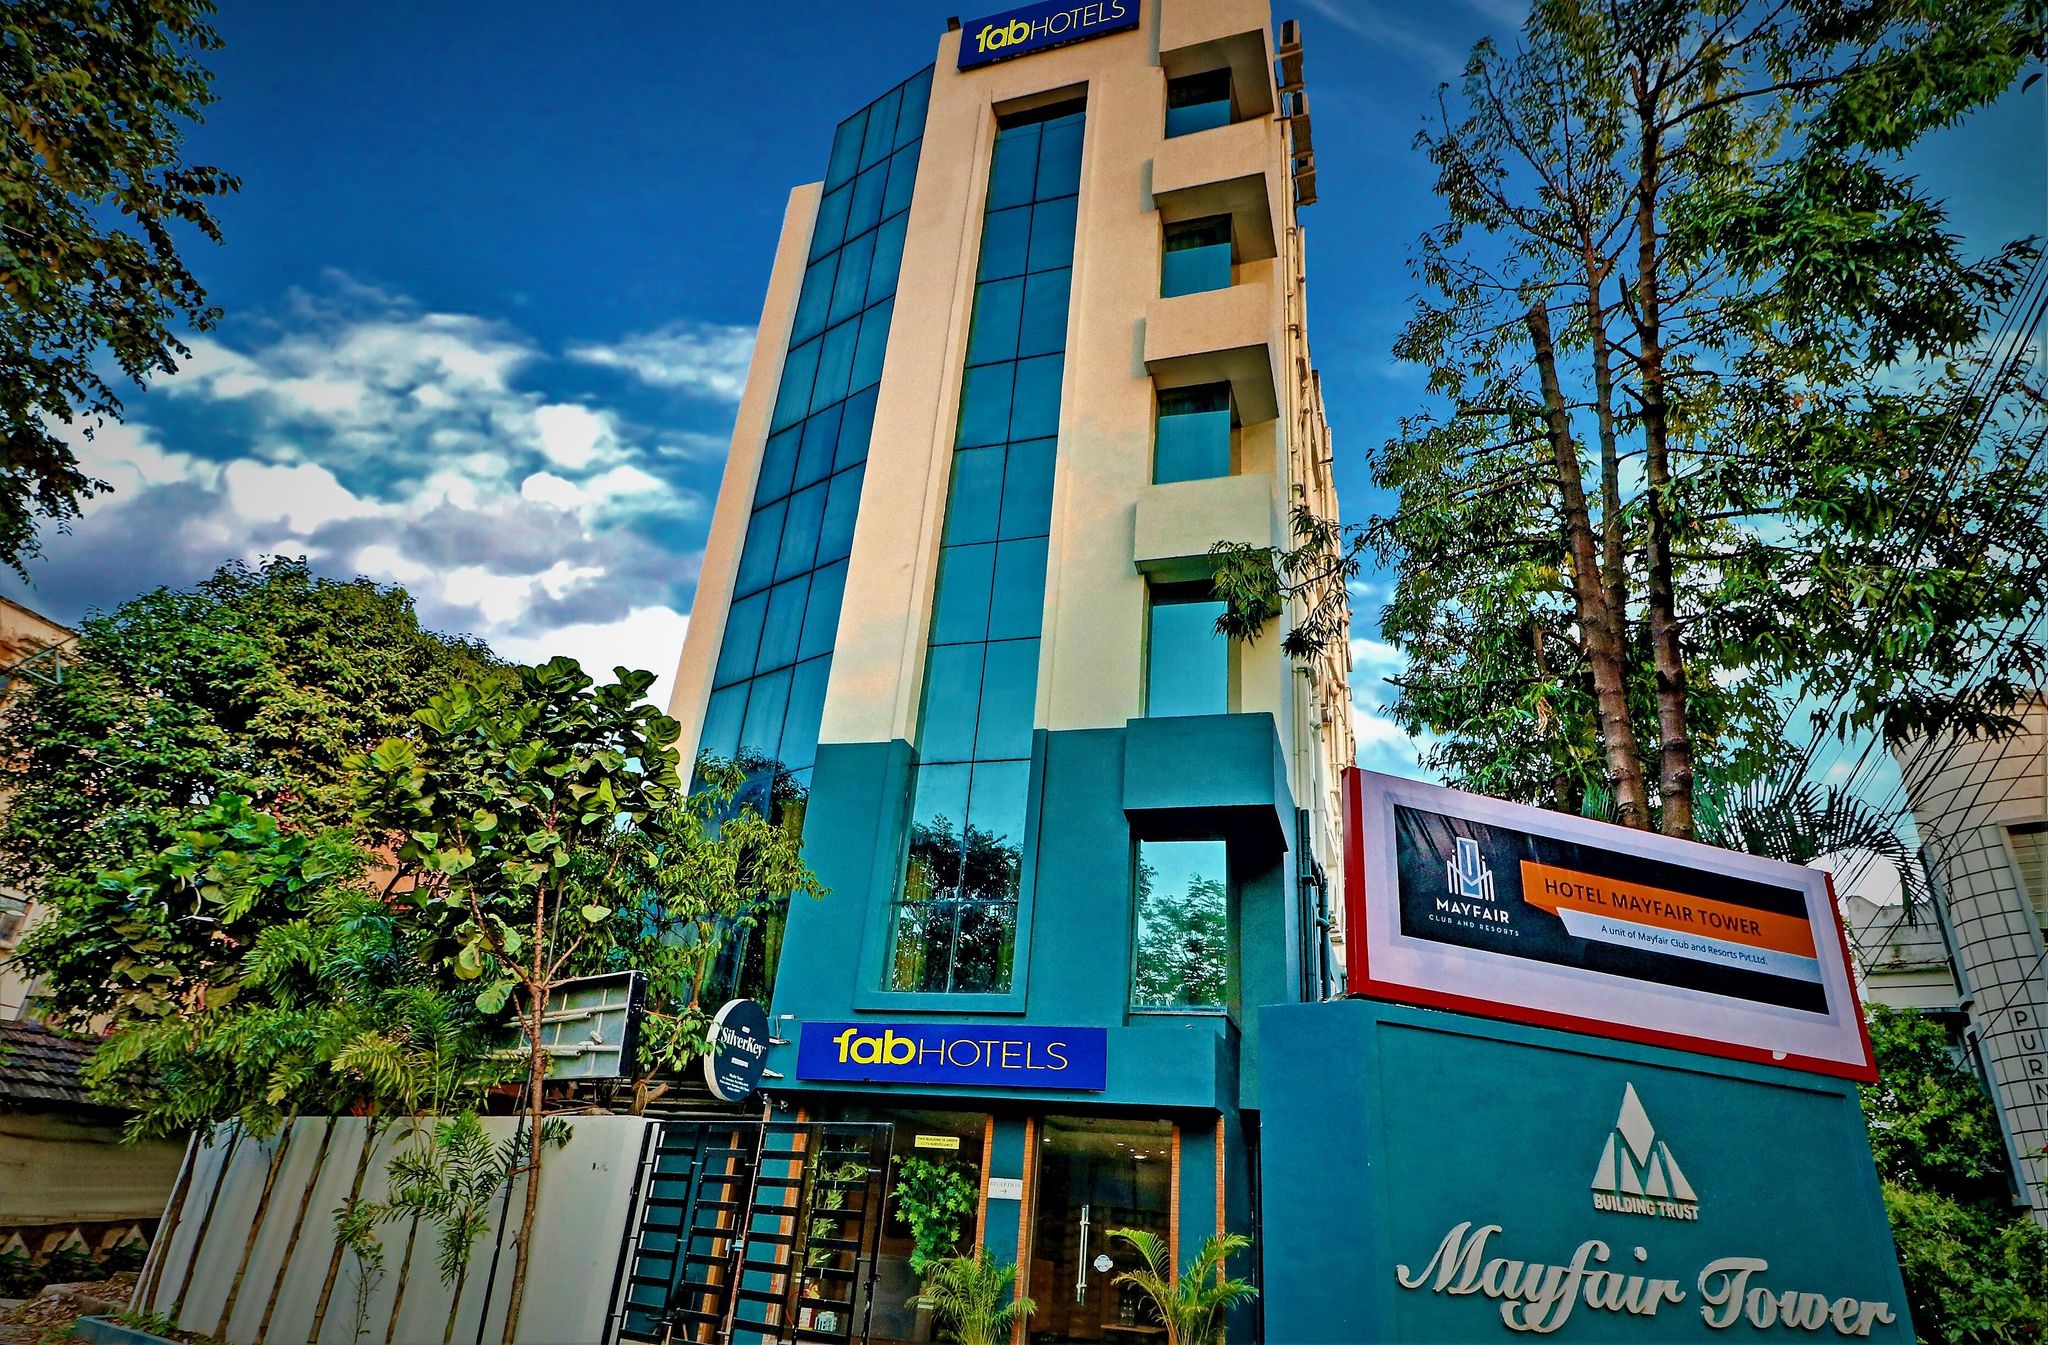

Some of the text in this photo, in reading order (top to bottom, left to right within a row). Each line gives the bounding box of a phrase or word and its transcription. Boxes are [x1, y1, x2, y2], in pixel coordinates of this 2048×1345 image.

[1436, 897, 1510, 924] MAYFAIR
[1545, 878, 1761, 937] HOTEL MAYFAIR TOWER
[1428, 914, 1519, 937] CLUB AND RESORTS
[1601, 925, 1608, 934] A
[1609, 926, 1626, 938] unit
[1627, 930, 1637, 939] of
[1638, 932, 1669, 945] Mayfair
[1670, 938, 1689, 950] Club
[1690, 943, 1706, 953] and
[1707, 946, 1738, 960] Resorts
[720, 1026, 764, 1060] SilverKey
[1593, 1193, 1701, 1220] BUILDING TRUST
[1396, 1221, 1896, 1336] Mayfair Tower
